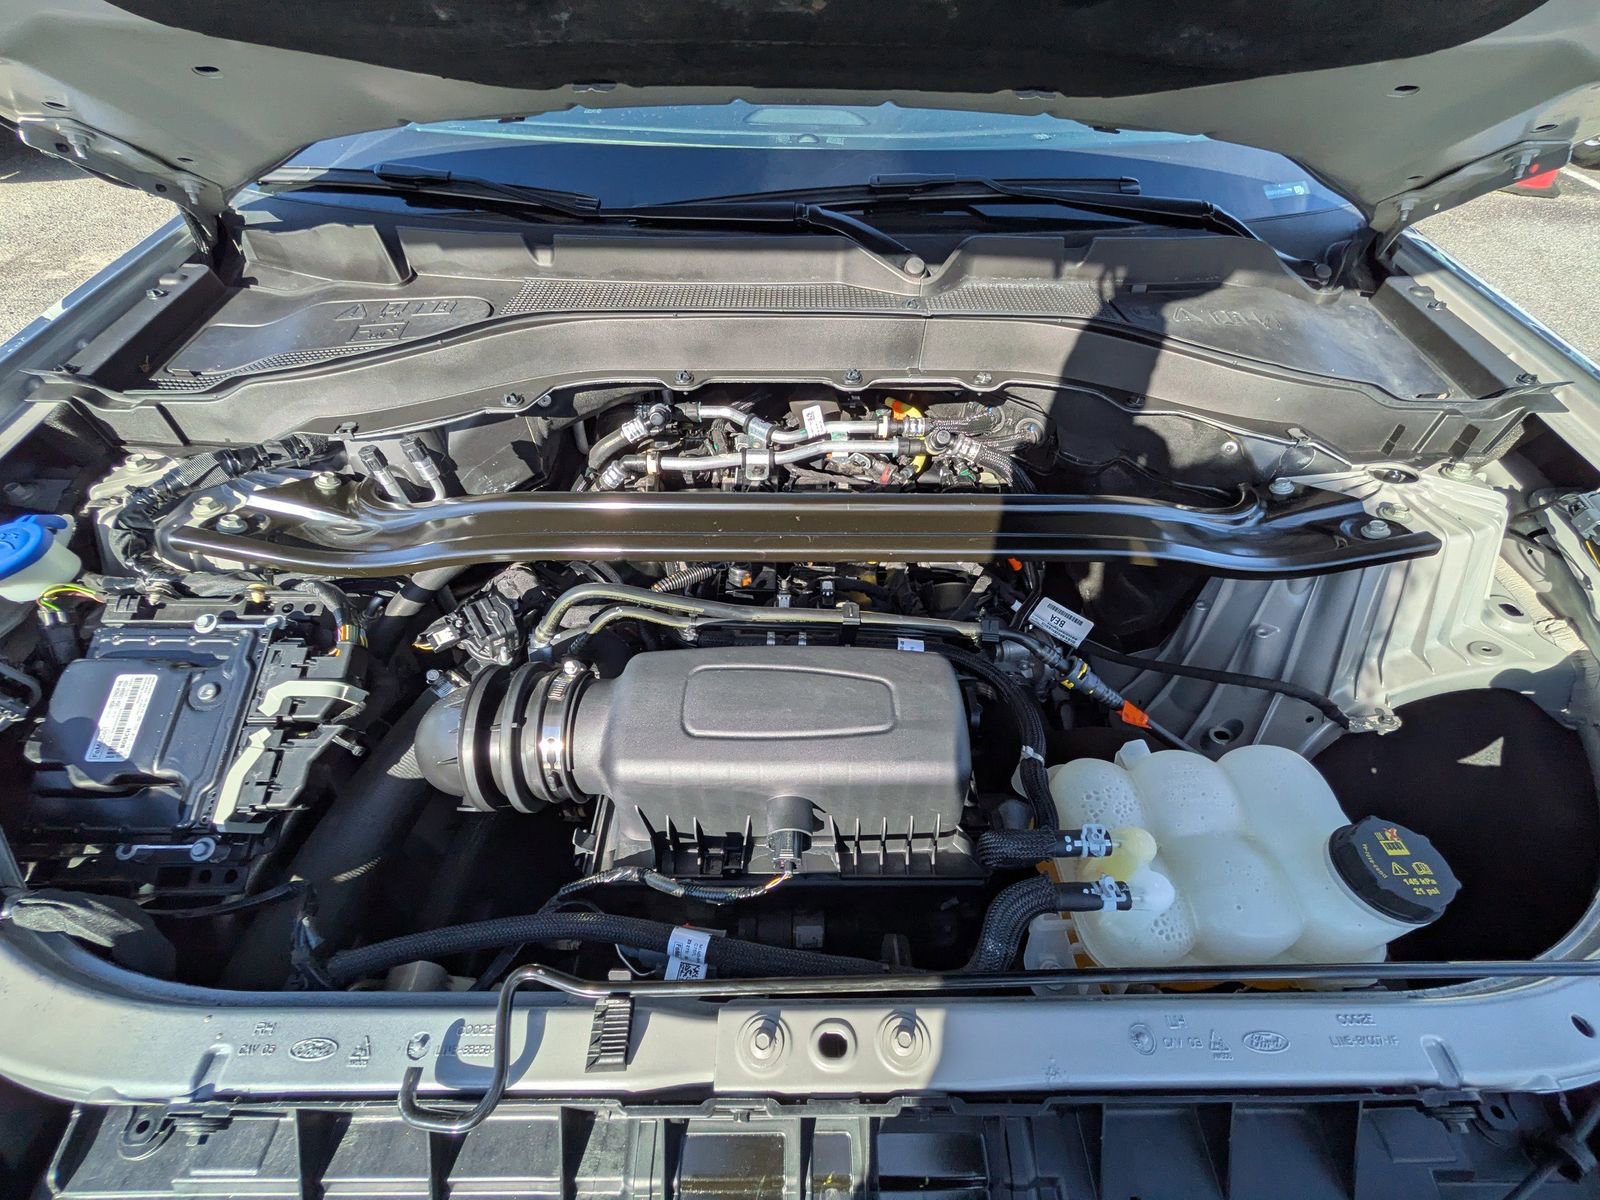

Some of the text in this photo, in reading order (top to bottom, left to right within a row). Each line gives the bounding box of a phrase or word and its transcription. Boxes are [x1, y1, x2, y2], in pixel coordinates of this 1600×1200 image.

[1050, 614, 1066, 628] BEA
[120, 727, 132, 749] BOSCH
[1412, 887, 1440, 897] 21 psi
